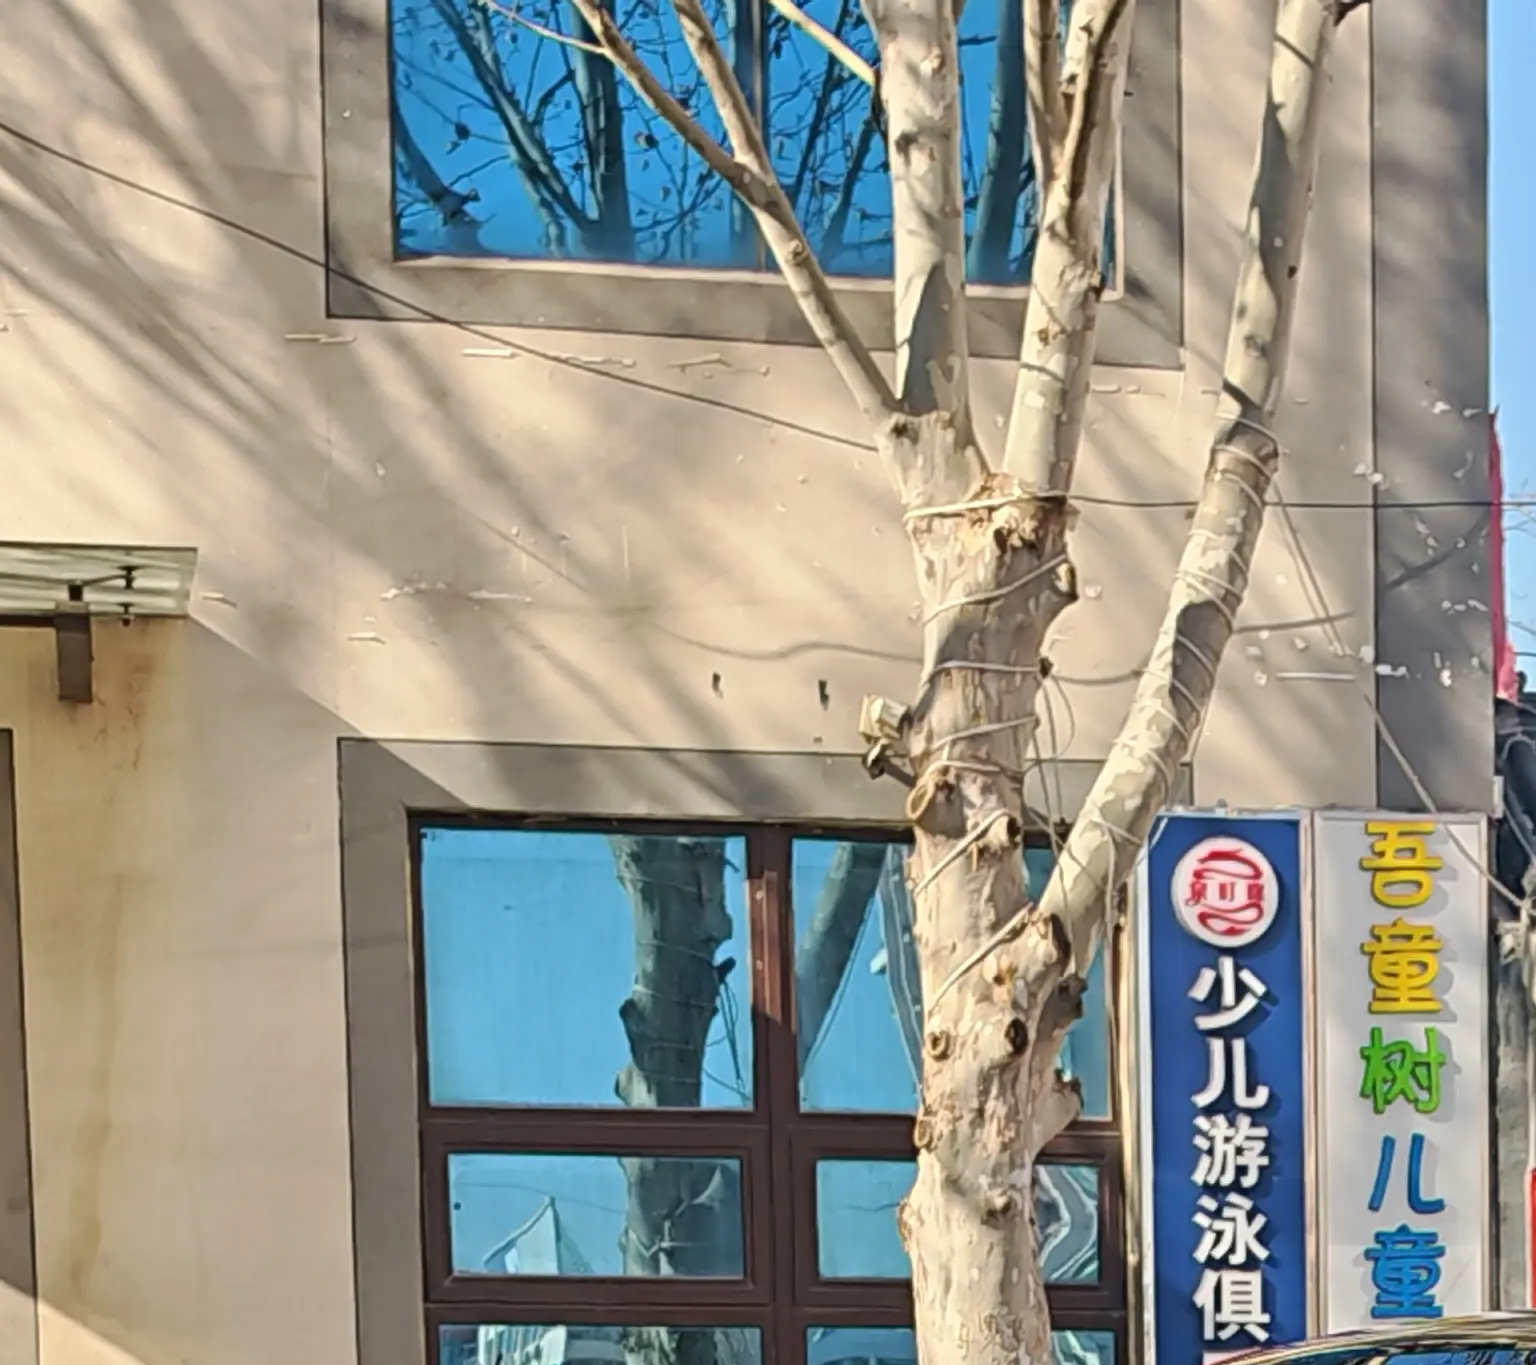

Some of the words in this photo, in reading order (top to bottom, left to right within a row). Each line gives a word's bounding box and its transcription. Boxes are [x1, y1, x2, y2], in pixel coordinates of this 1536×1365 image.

[1360, 820, 1447, 1319] 吾童树儿童
